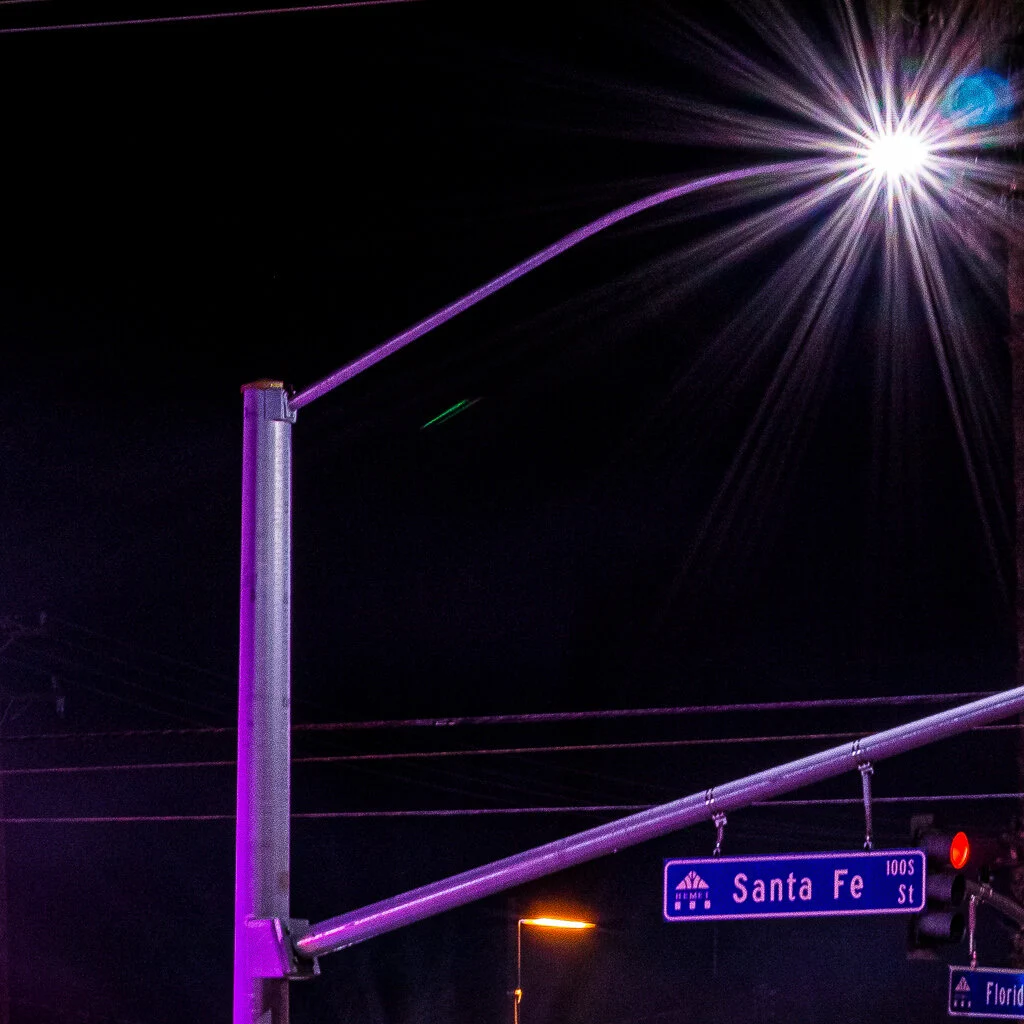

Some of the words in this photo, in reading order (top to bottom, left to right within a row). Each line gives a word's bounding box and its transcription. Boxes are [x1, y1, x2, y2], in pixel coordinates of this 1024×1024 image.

[887, 859, 915, 876] 100S
[733, 872, 812, 903] Santa
[833, 869, 864, 900] Fe
[898, 884, 914, 904] St
